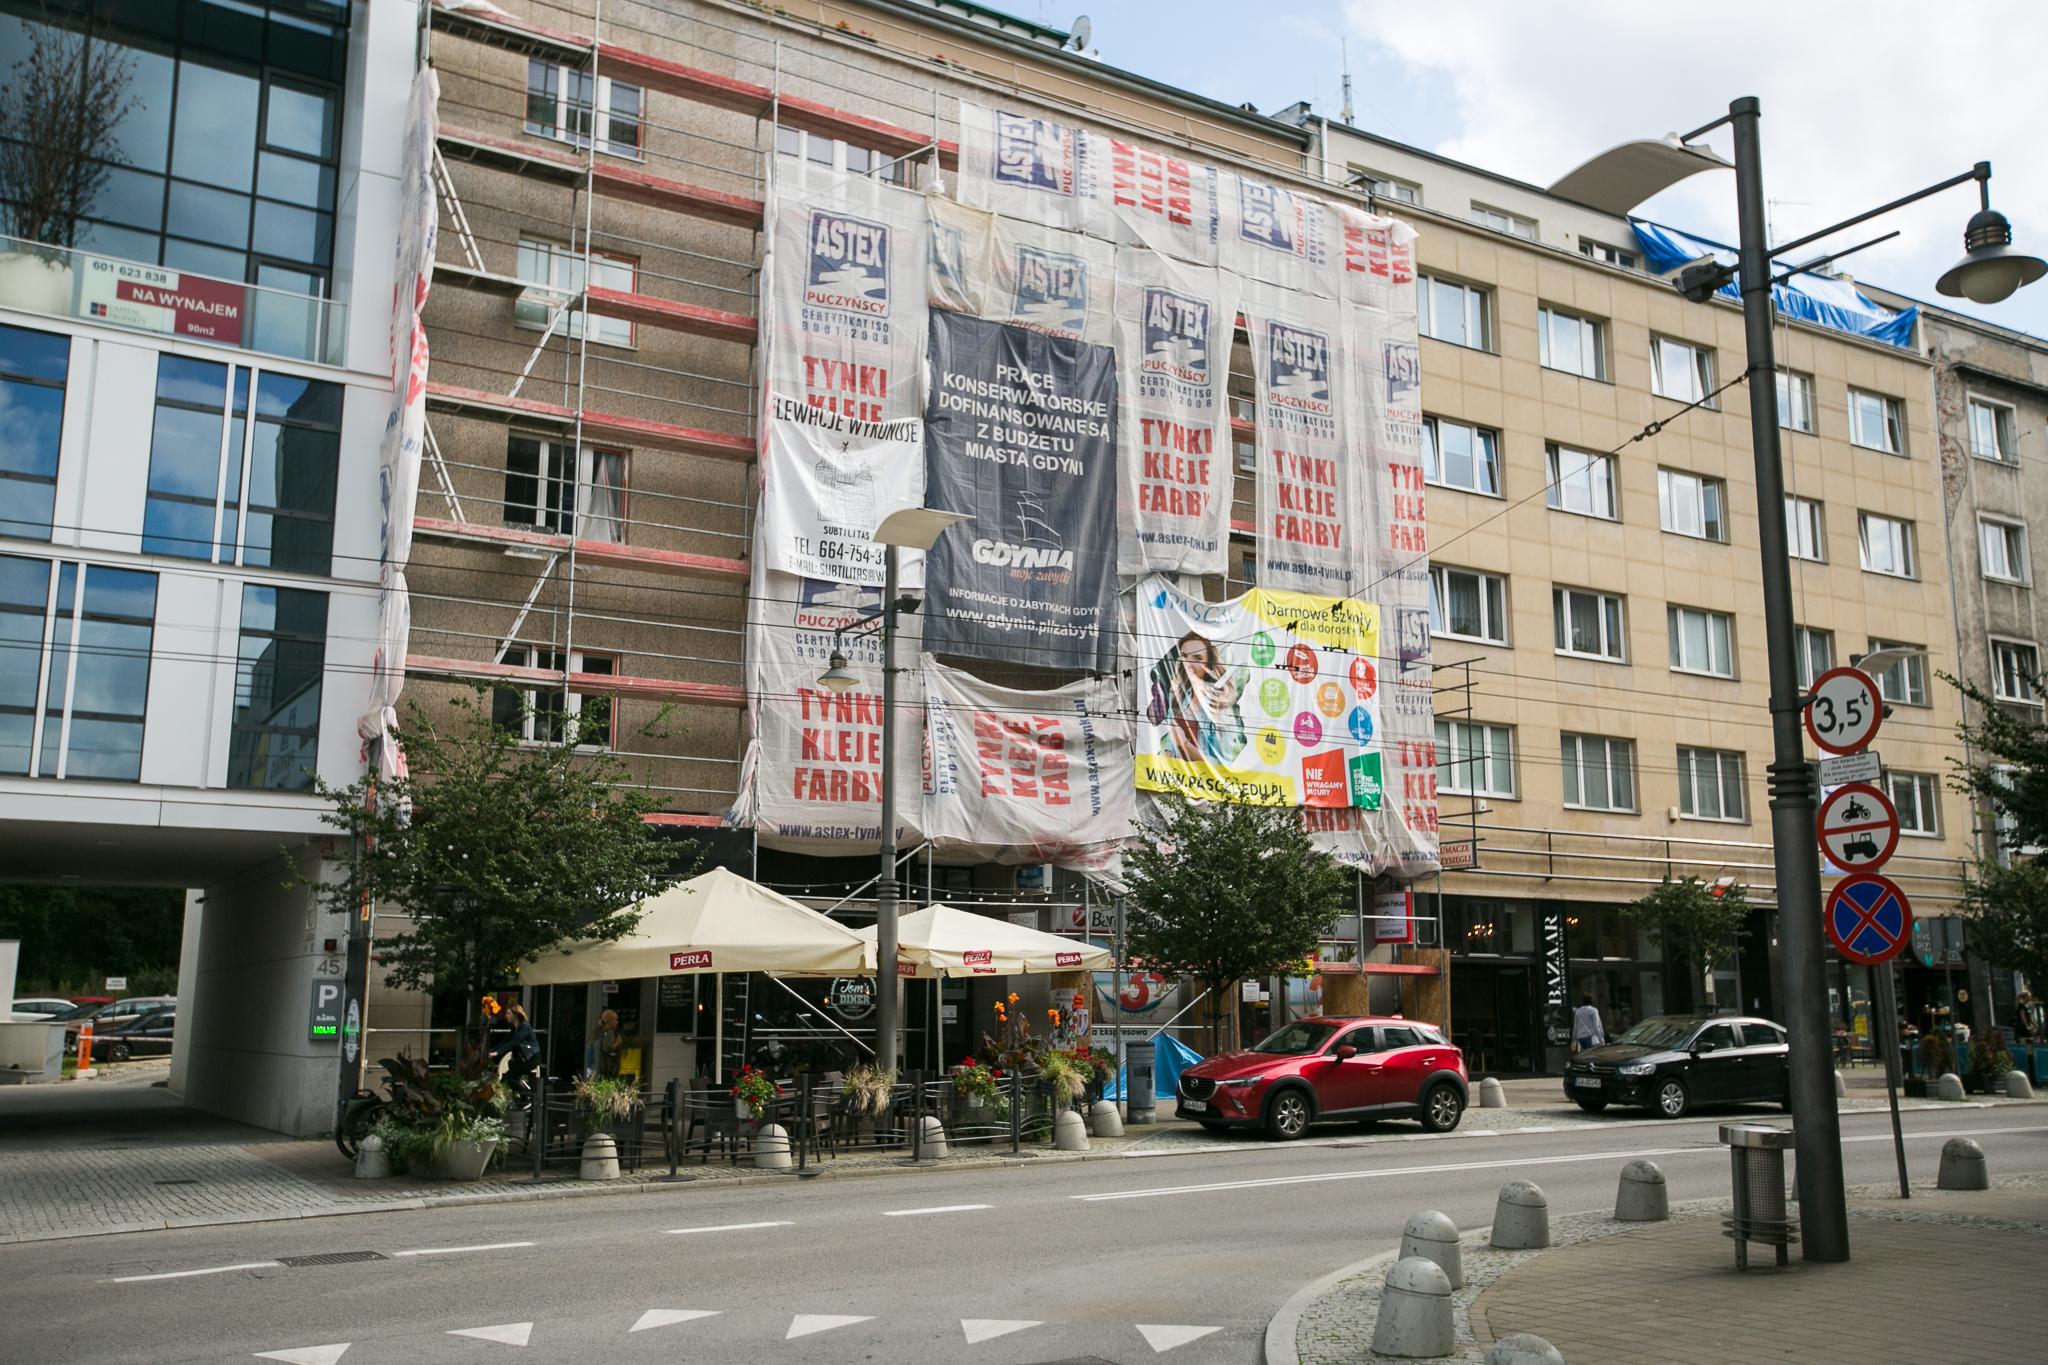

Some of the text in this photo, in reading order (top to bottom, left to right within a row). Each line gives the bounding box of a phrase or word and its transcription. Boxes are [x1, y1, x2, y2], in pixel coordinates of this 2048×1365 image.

[1000, 115, 1034, 182] ASTEX
[1243, 182, 1273, 242] ASTE
[815, 217, 883, 268] ASTEX
[1344, 223, 1366, 273] TYN
[93, 261, 167, 284] 601 623 838
[1021, 256, 1083, 299] ASTEX
[132, 287, 238, 319] NA WYNAJEM
[806, 290, 887, 314] PUCZYŃSCY
[1148, 294, 1205, 341] ASTEX
[187, 323, 216, 337] 90m2
[801, 308, 890, 333] CERTYFIKAT ISO
[1271, 328, 1325, 372] ASTEX
[803, 355, 888, 399] TYNKI
[996, 364, 1055, 390] PRACE
[1140, 375, 1212, 398] CERTYFIKAT ISO
[1144, 359, 1207, 383] PUCZYŃSCY
[943, 371, 1109, 418] KONSERWATORSKIE
[939, 391, 1111, 443] DOFINANSOWANE SĄ
[1319, 418, 1335, 429] ISO
[976, 422, 1075, 453] Z BUDŻETU
[1140, 418, 1213, 454] TYNKI
[965, 441, 1085, 476] MIASTA GDYNI
[1143, 451, 1210, 486] KLEJE
[1272, 449, 1337, 488] TYNKI
[1139, 484, 1212, 517] FARBY
[1277, 482, 1337, 518] KLEJE
[823, 525, 870, 541] SUBTILITAS
[1275, 513, 1342, 549] FARBY
[794, 535, 886, 565] TEL. 664-754-3
[971, 538, 1074, 571] GDYNIA
[949, 587, 1009, 607] INFORMACJE
[1010, 596, 1018, 607] O
[1019, 598, 1072, 616] ZABYTKACH
[1267, 600, 1329, 621] Darmowe
[1300, 620, 1316, 633] dla
[797, 687, 884, 726] TYNKI
[801, 728, 881, 765] KLEJE
[1032, 715, 1071, 806] FARBY
[793, 768, 884, 804] FARBY
[1305, 768, 1324, 780] NIE
[1306, 781, 1344, 790] WYMAGAMY
[317, 959, 340, 975] 45
[1544, 914, 1562, 1005] BAZAAR
[318, 984, 339, 1008] P
[840, 994, 870, 1004] DINER
[1099, 1028, 1148, 1038] Ekspesowa
